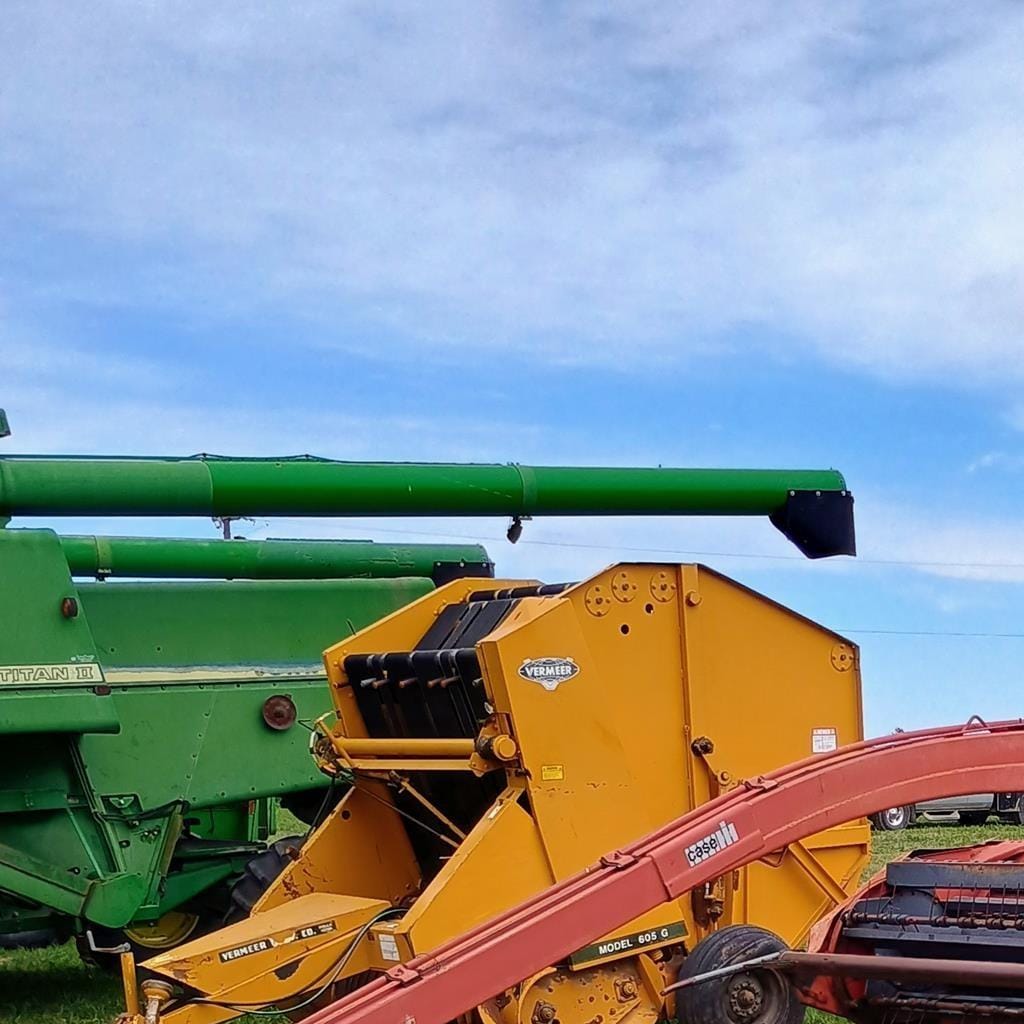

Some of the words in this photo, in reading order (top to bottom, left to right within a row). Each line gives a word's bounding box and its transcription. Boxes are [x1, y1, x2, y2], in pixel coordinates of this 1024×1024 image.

[0, 667, 69, 682] TITAN
[525, 666, 571, 676] VERMEER
[599, 939, 633, 955] MODEL
[638, 931, 657, 944] 605
[661, 928, 669, 938] G
[221, 941, 267, 961] VERMEER
